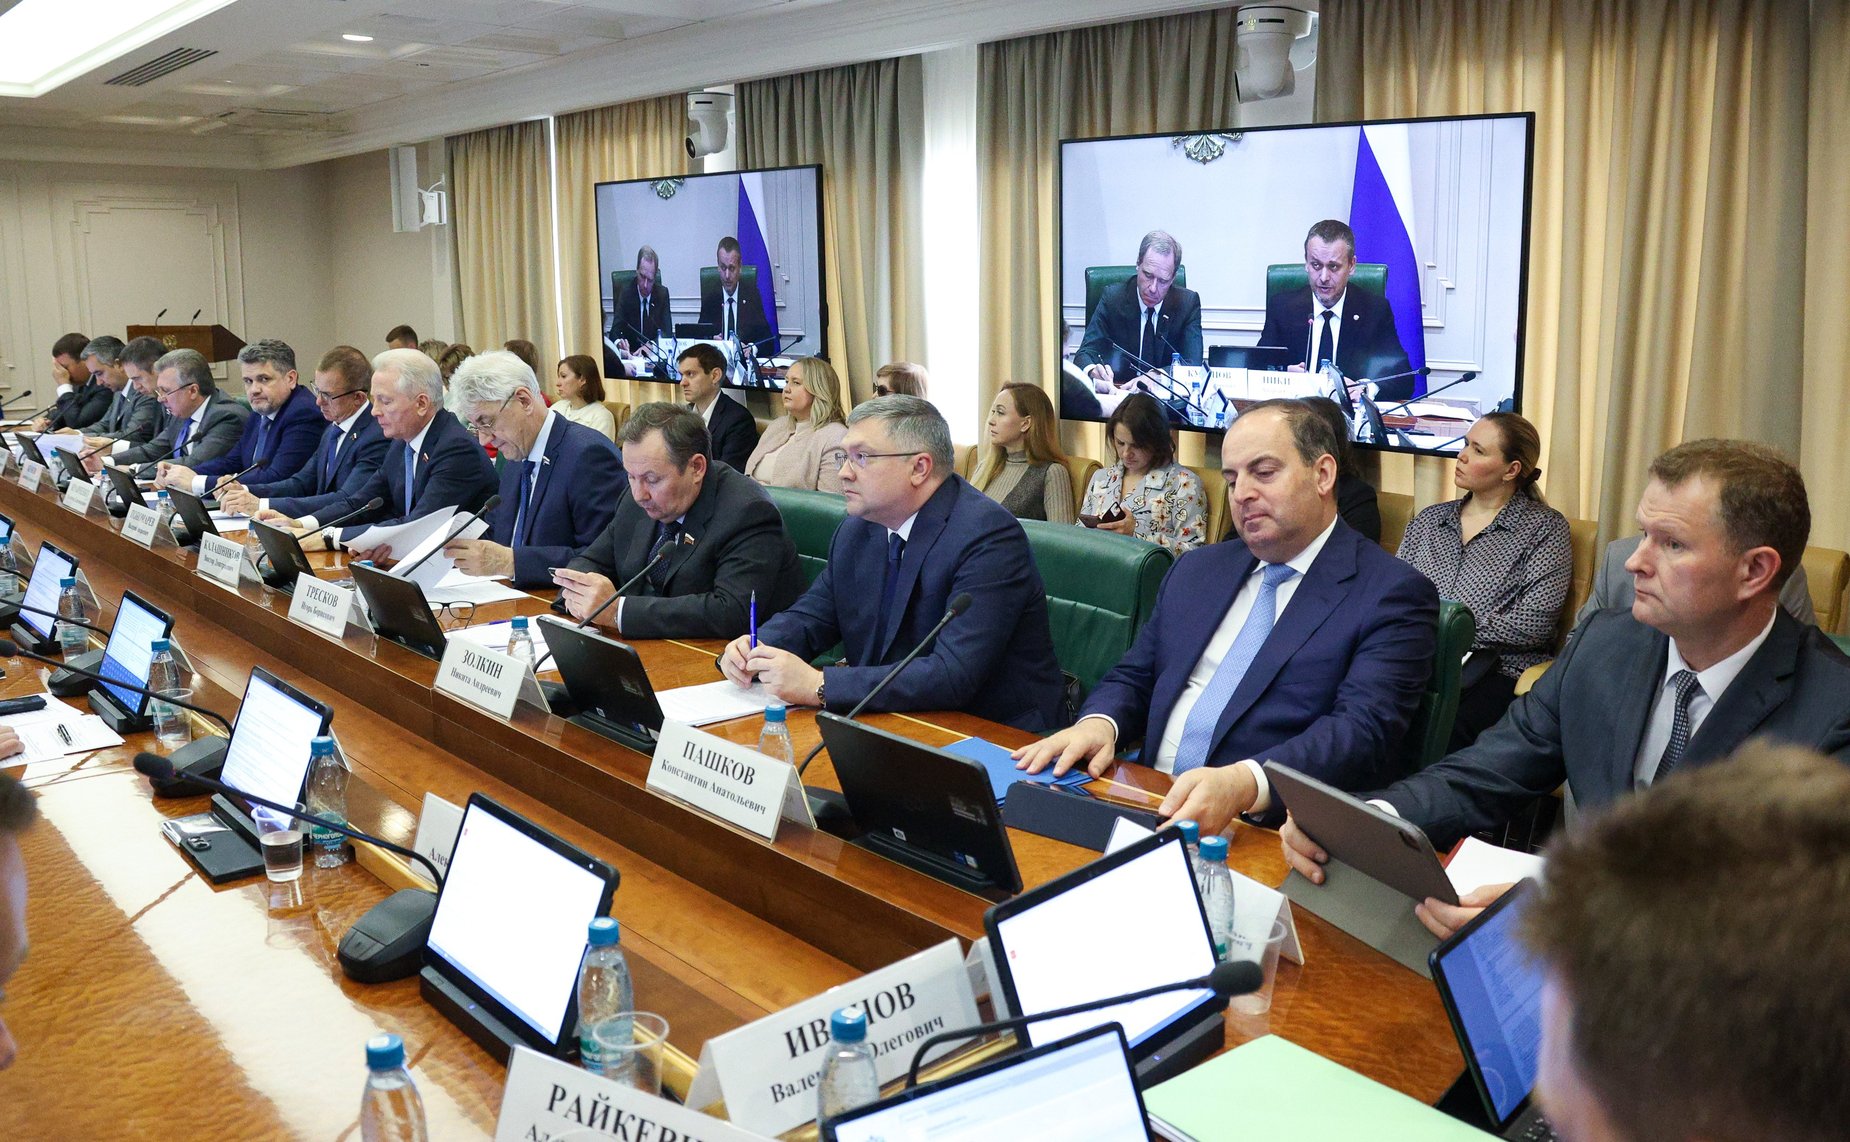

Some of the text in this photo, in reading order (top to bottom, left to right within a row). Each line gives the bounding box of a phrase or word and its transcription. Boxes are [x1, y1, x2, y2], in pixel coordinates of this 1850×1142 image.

[306, 585, 339, 608] ТРЕСКОВ
[451, 667, 502, 699] Никита Андреевич
[462, 649, 503, 679] ЗОЛКИН
[682, 741, 756, 786] ПАШКОВ
[661, 759, 766, 815] Константин Анатольевич
[784, 982, 916, 1059] ИВНОВ
[770, 1071, 821, 1104] Вале
[546, 1083, 704, 1142] РАЙКЕВ
